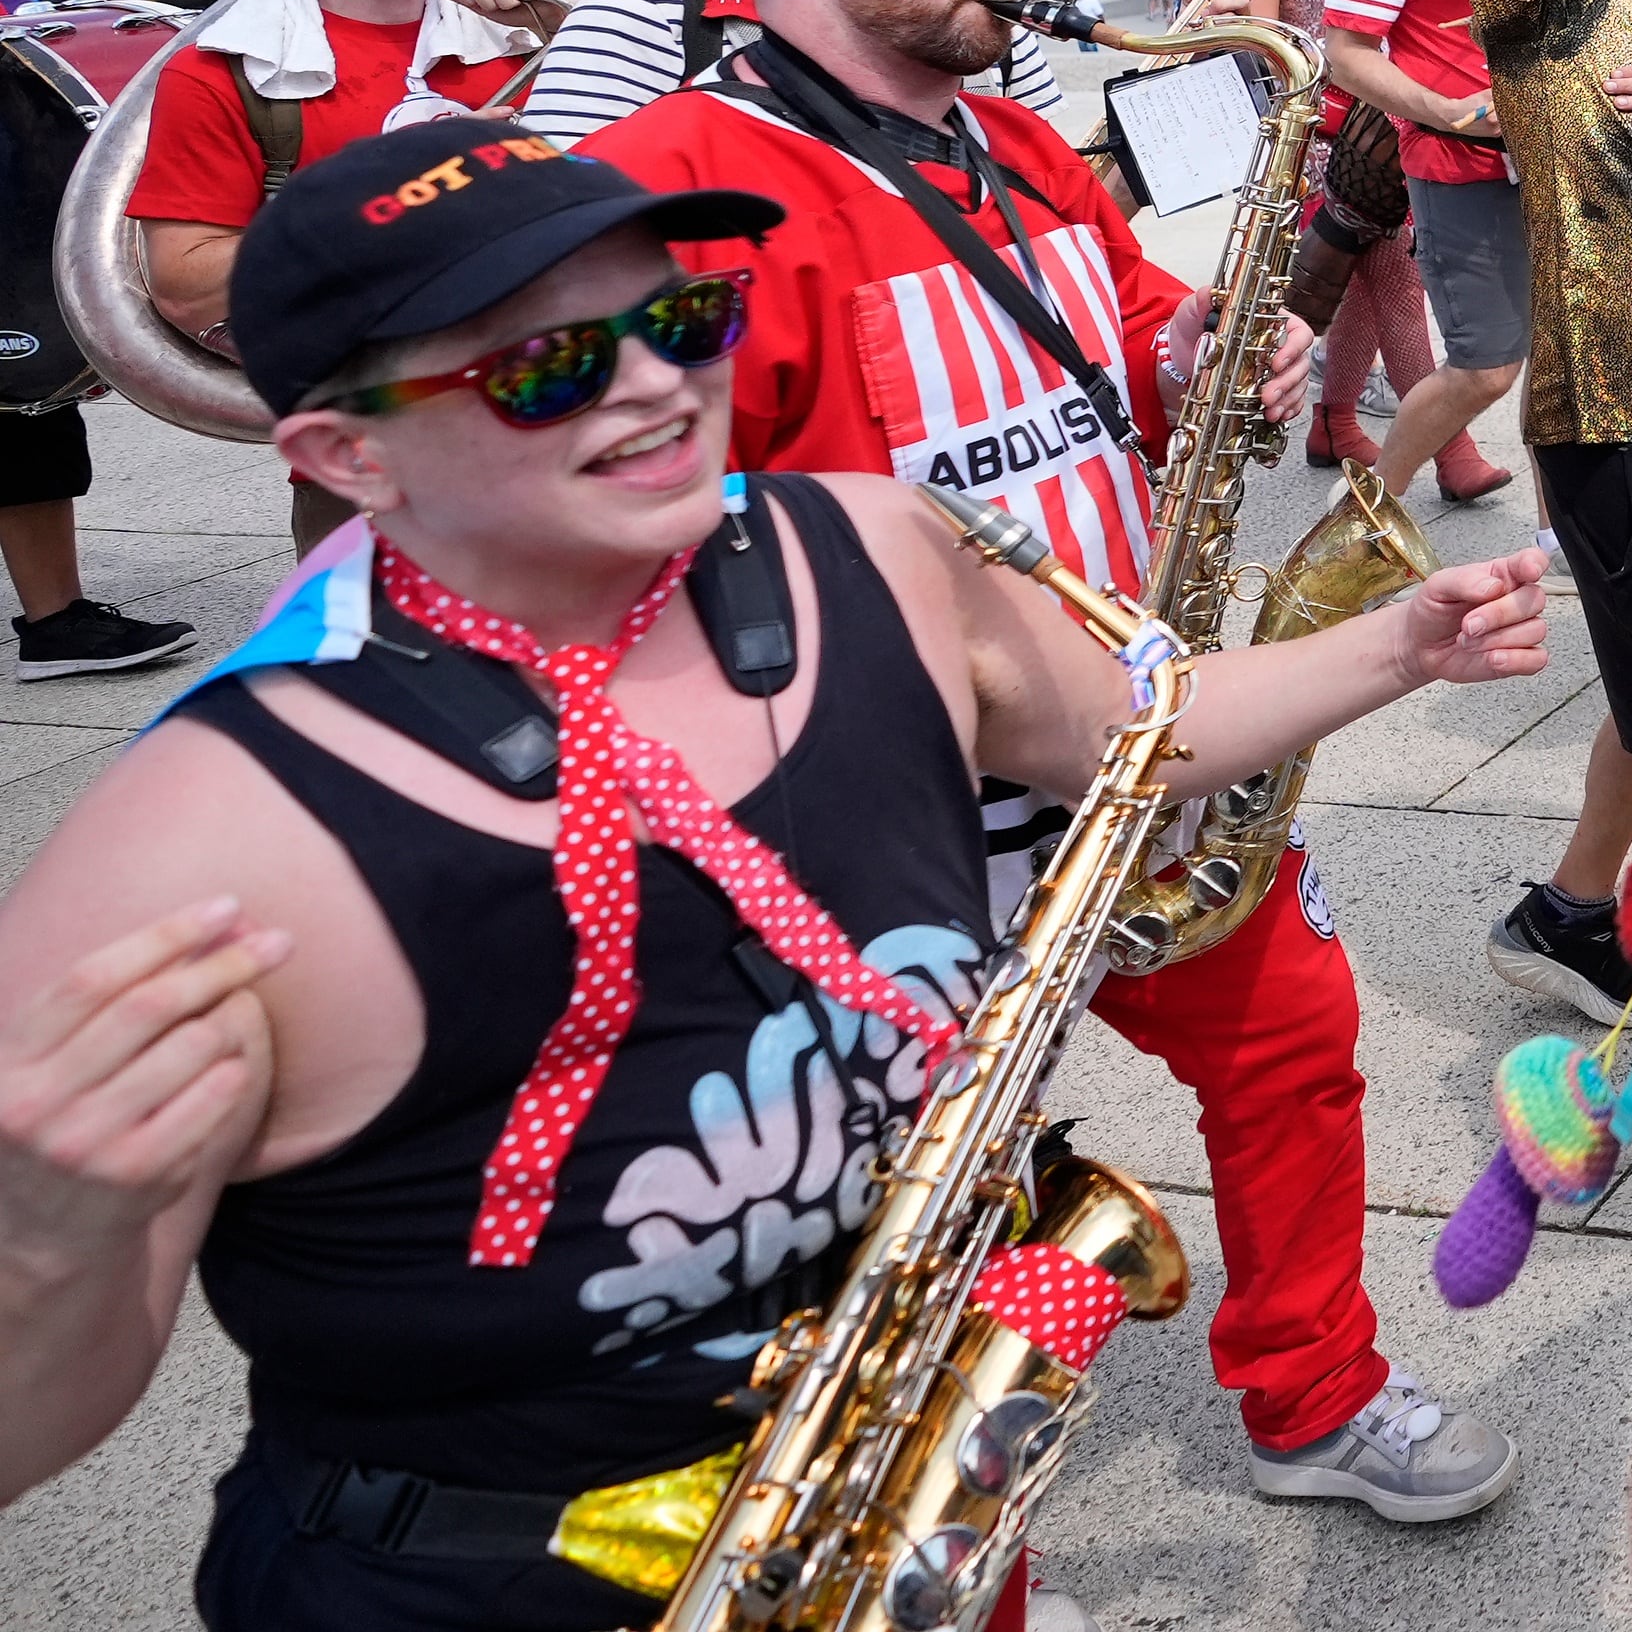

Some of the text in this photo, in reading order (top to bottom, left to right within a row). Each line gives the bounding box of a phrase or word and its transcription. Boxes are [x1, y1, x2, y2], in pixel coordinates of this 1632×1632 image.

[0, 337, 31, 351] ANS
[928, 397, 1101, 491] ABOLIS
[1522, 910, 1555, 954] saucony
